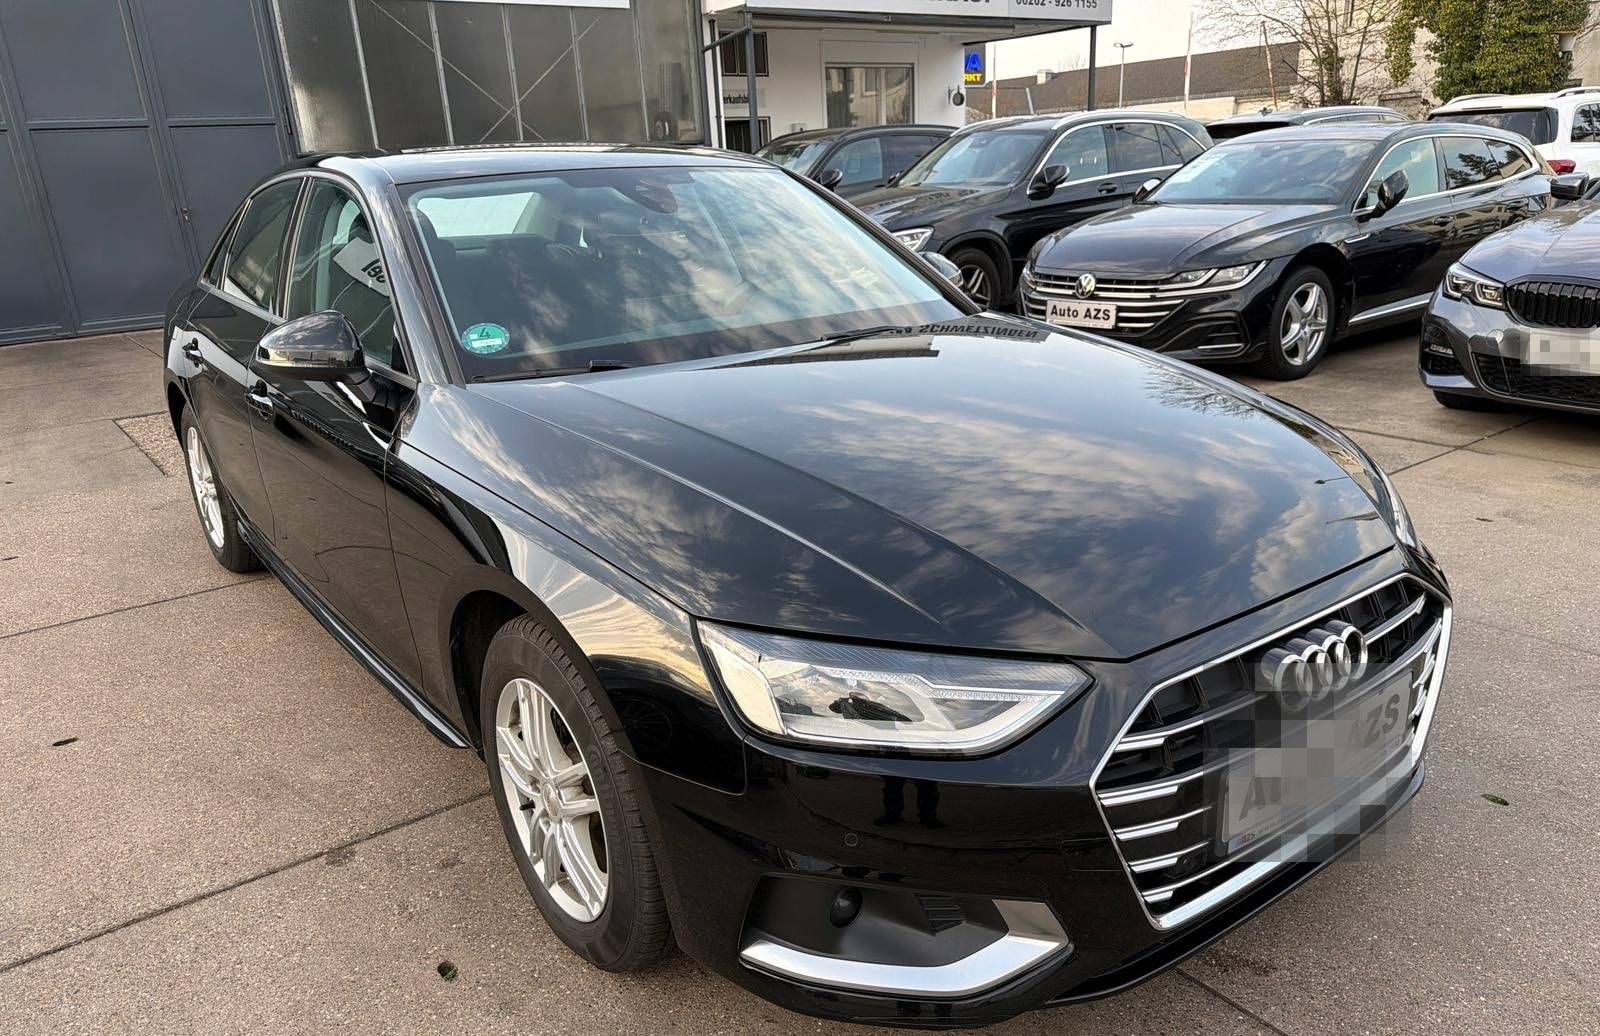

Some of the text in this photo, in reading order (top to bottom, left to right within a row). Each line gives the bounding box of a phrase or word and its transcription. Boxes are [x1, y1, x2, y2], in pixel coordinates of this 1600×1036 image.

[1075, 0, 1098, 9] 1155
[1050, 304, 1111, 321] Auto AZS
[480, 327, 491, 339] 4
[1343, 695, 1399, 760] AZS
